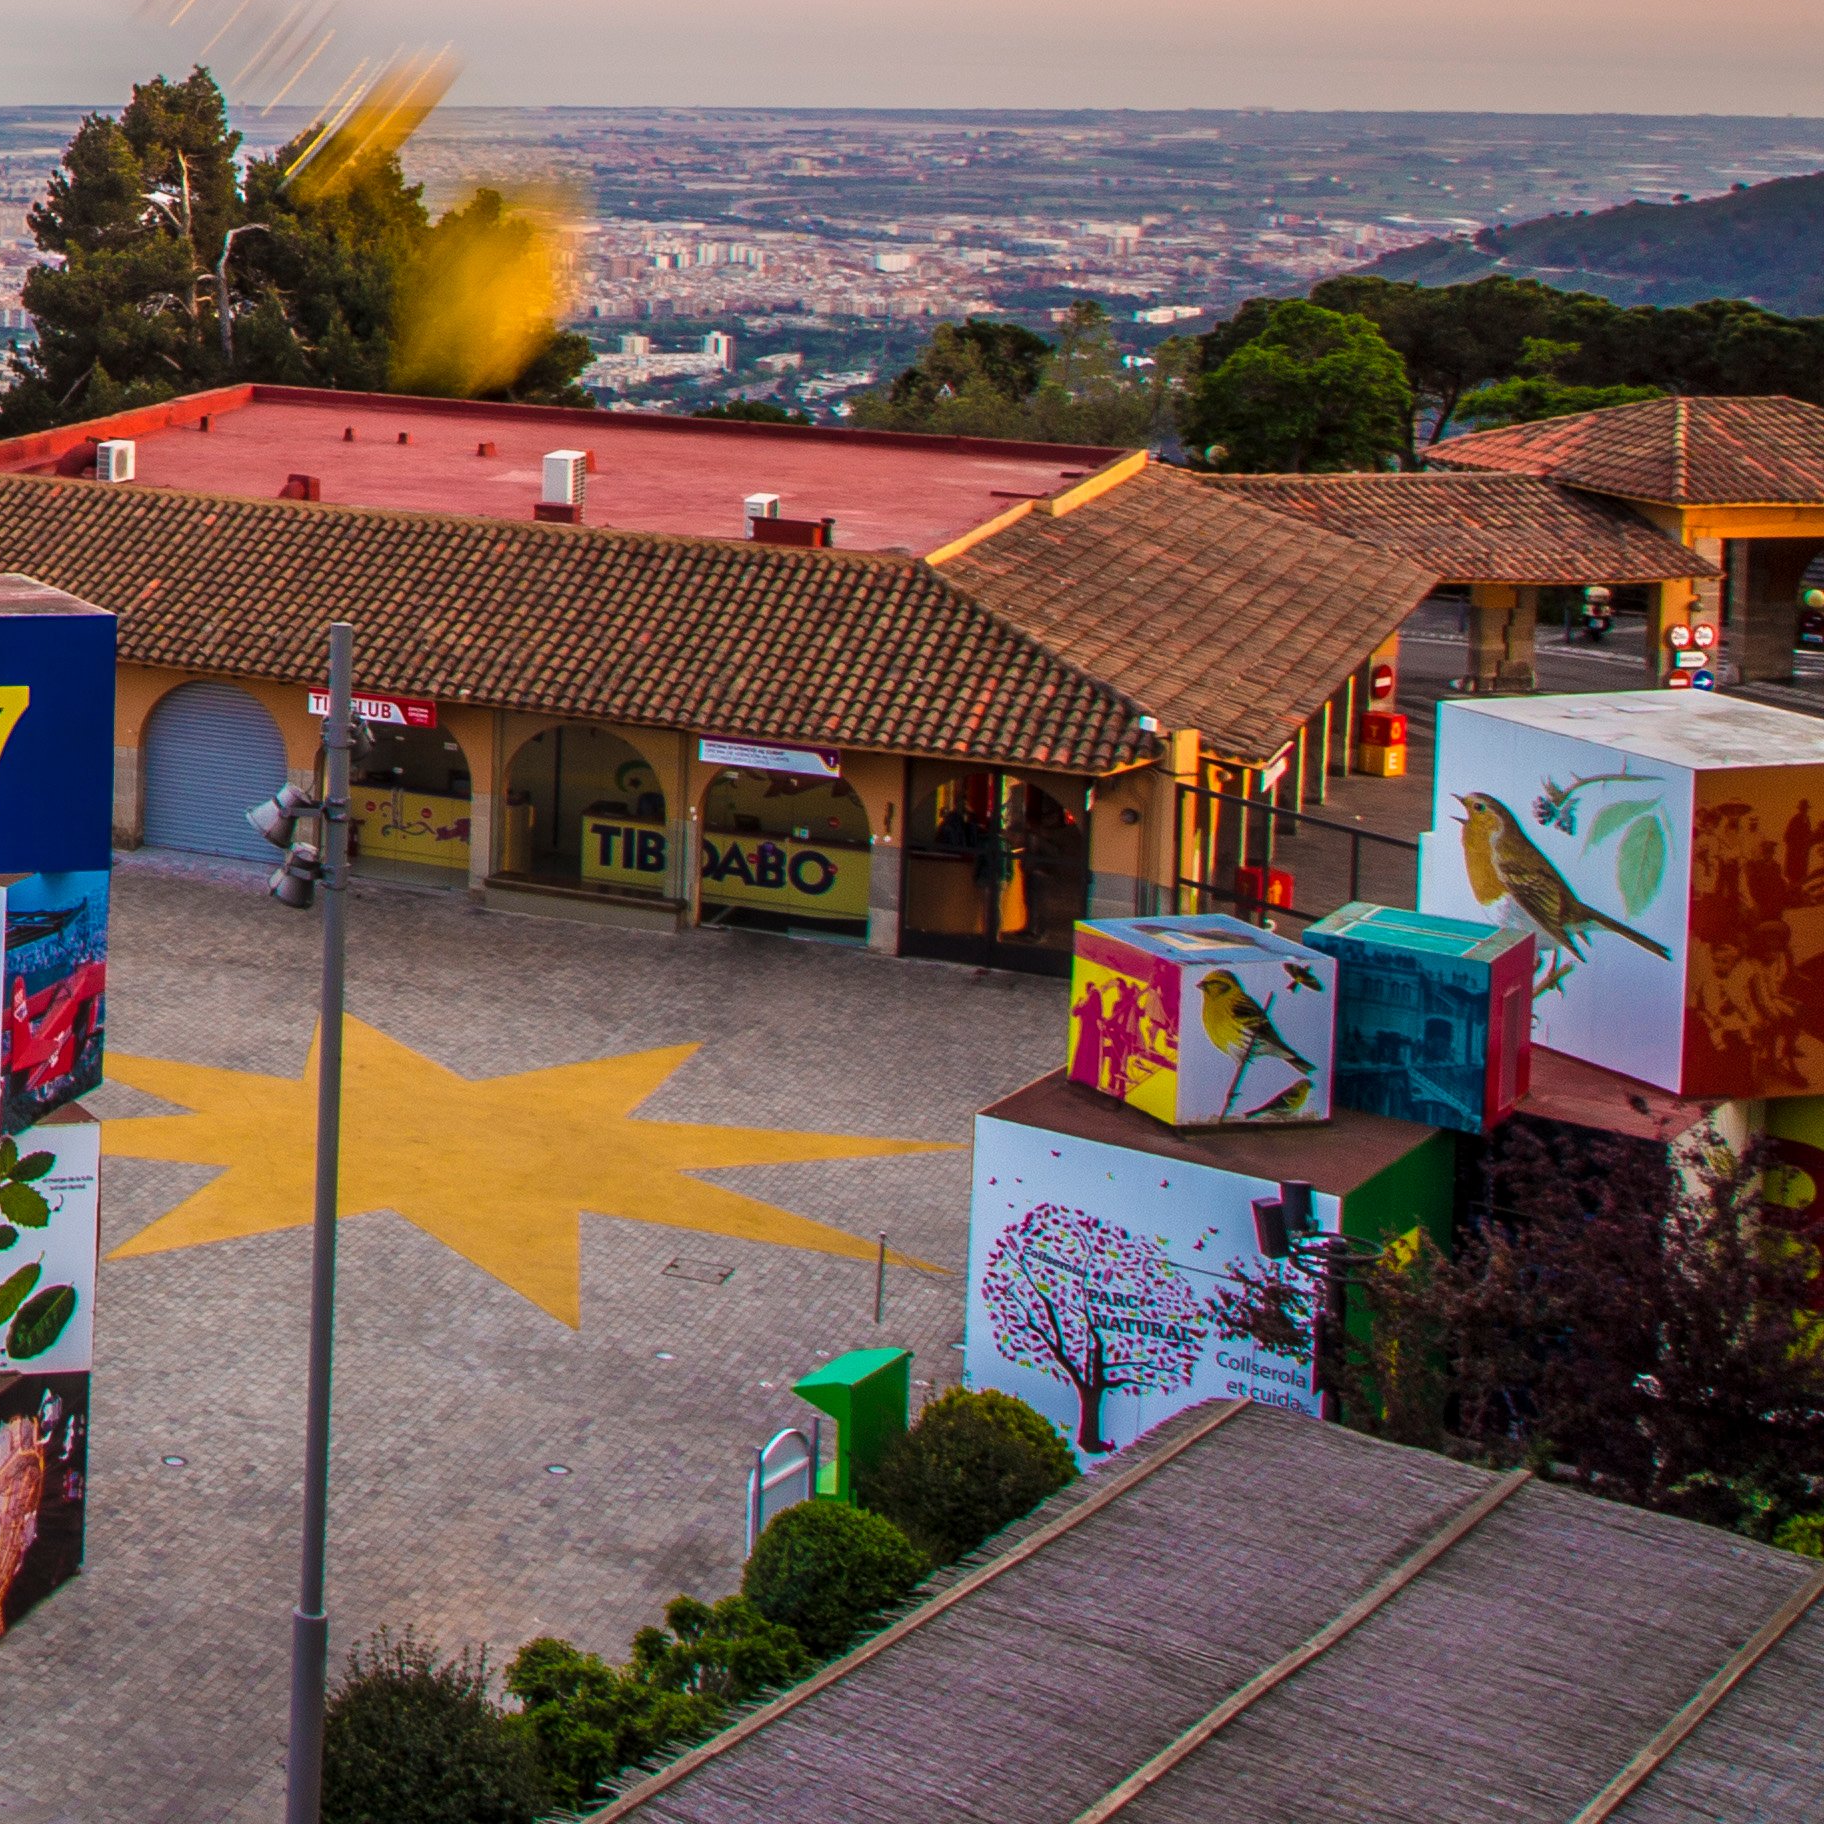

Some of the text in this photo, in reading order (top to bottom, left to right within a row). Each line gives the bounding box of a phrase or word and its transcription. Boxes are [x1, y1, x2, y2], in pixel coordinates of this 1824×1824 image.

[313, 696, 392, 718] TICLUB
[1388, 752, 1398, 769] E
[591, 824, 837, 895] TIBABO
[1086, 1288, 1138, 1309] PARC
[1092, 1313, 1193, 1344] NATURAL
[1215, 1351, 1306, 1389] Collserola
[1226, 1380, 1246, 1396] et
